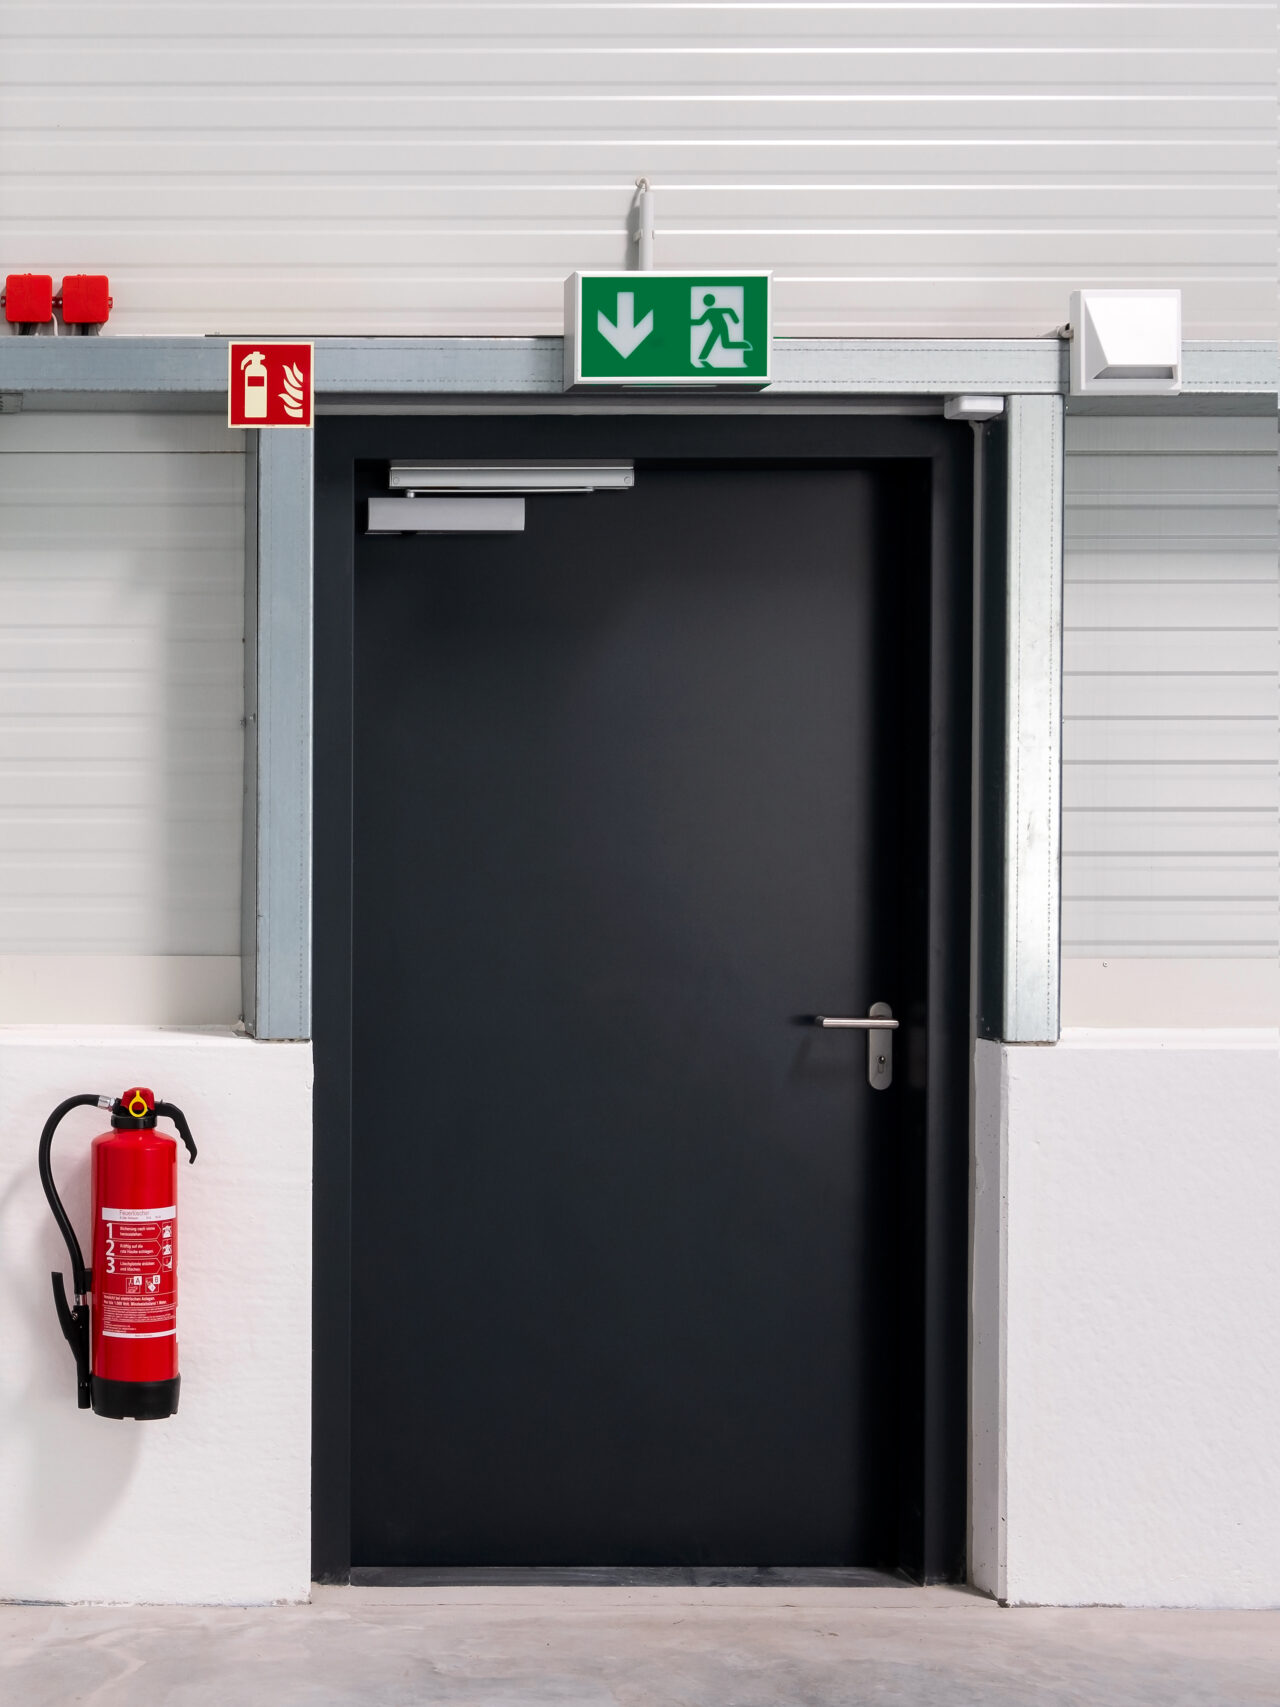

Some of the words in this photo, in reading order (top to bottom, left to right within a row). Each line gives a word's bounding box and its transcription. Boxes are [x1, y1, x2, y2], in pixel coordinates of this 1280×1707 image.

[106, 1222, 112, 1239] 1
[106, 1240, 114, 1256] 2
[106, 1257, 115, 1273] 3
